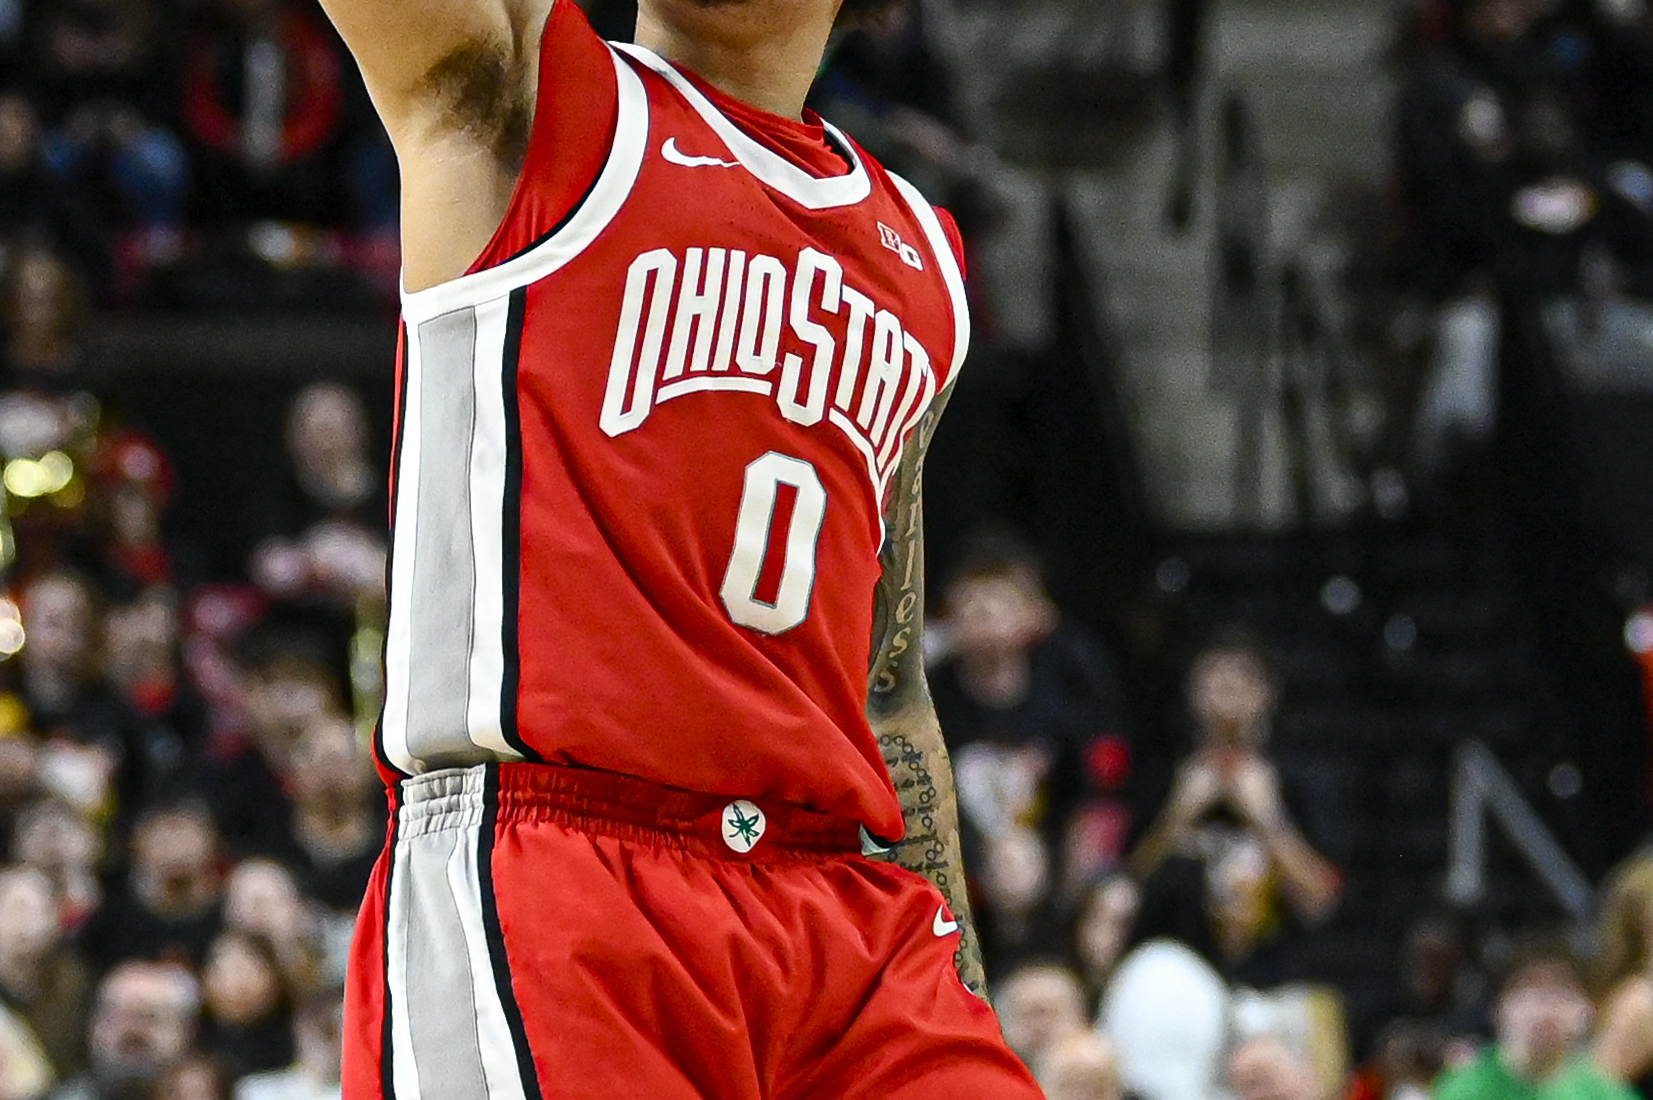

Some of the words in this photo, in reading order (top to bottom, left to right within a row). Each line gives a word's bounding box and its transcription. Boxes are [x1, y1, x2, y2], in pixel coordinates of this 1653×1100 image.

[598, 247, 787, 437] OHIO
[719, 450, 827, 636] 0
[873, 409, 937, 693] earless
